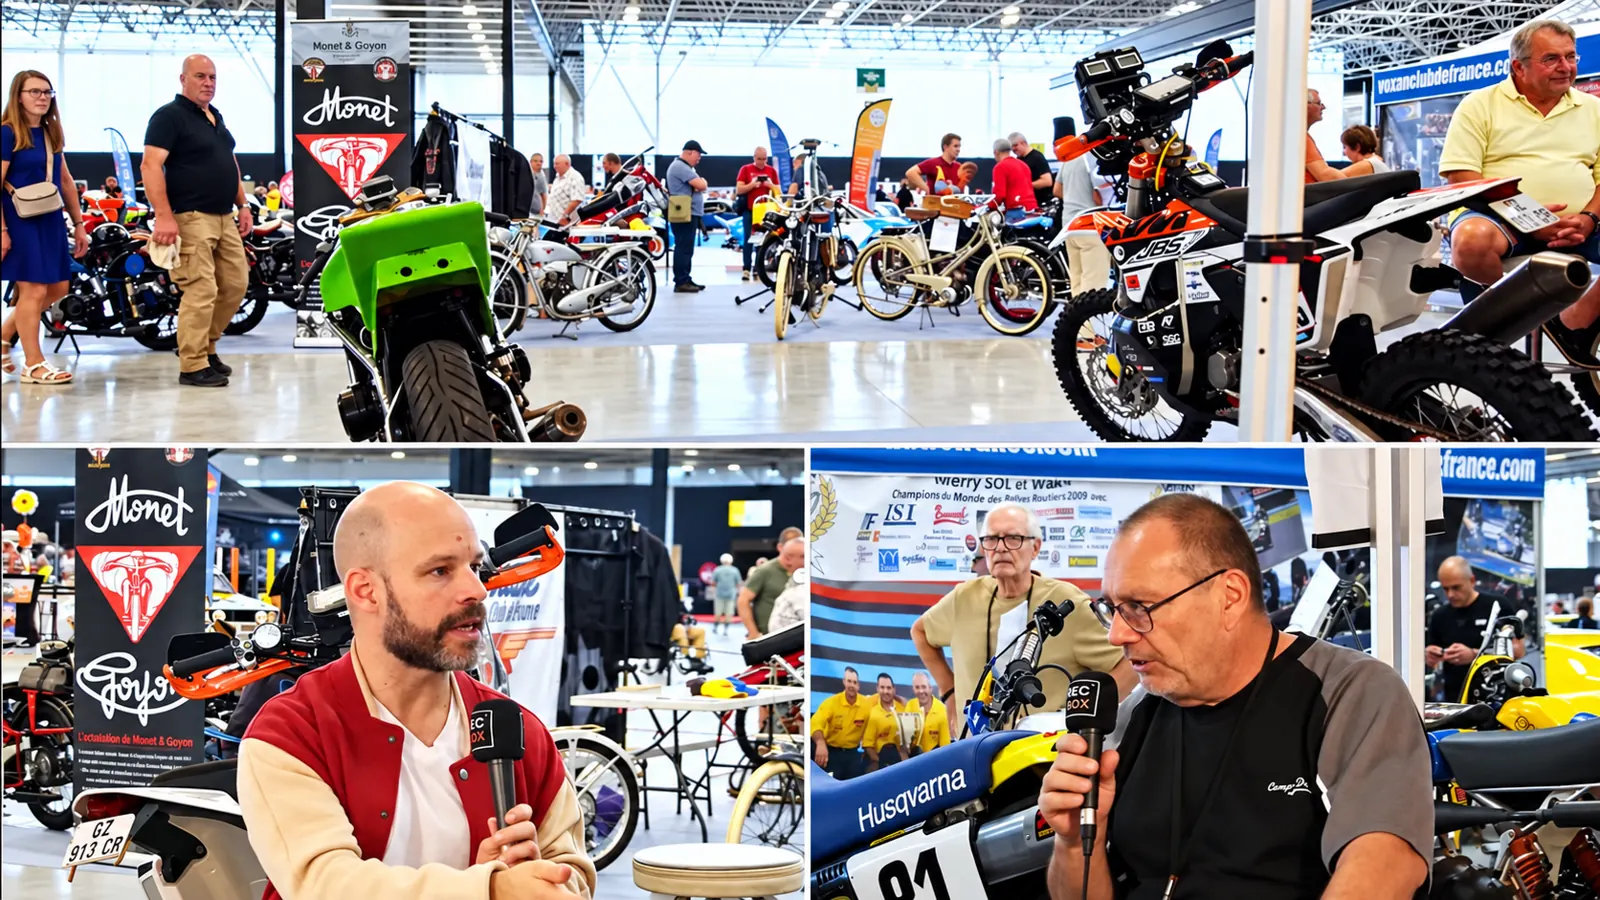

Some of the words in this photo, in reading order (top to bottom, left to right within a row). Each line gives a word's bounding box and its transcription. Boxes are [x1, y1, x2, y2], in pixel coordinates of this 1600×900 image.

[313, 41, 343, 51] Monet
[344, 41, 352, 50] &
[355, 41, 387, 52] Goyon
[1377, 57, 1511, 95] voxanclubdefrance.co
[303, 85, 399, 127] Monet
[1135, 237, 1186, 260] JBS
[1440, 449, 1536, 482] france.com
[984, 477, 1011, 490] SOL
[1015, 479, 1028, 490] et
[85, 473, 194, 536] Monet
[892, 489, 941, 501] Champions
[941, 490, 952, 500] du
[953, 491, 985, 503] Monde
[987, 494, 1002, 503] des
[1031, 493, 1066, 502] Routiers
[1067, 491, 1088, 500] 2009
[1090, 493, 1108, 502] avec
[1067, 698, 1090, 711] BOX
[470, 717, 485, 730] EC
[121, 733, 131, 745] de
[132, 734, 158, 746] Monet
[166, 736, 194, 749] Goyon
[471, 731, 485, 743] OX
[857, 768, 967, 832] Husqvarna
[92, 819, 115, 839] GZ
[68, 841, 98, 862] 913
[101, 836, 124, 855] CR
